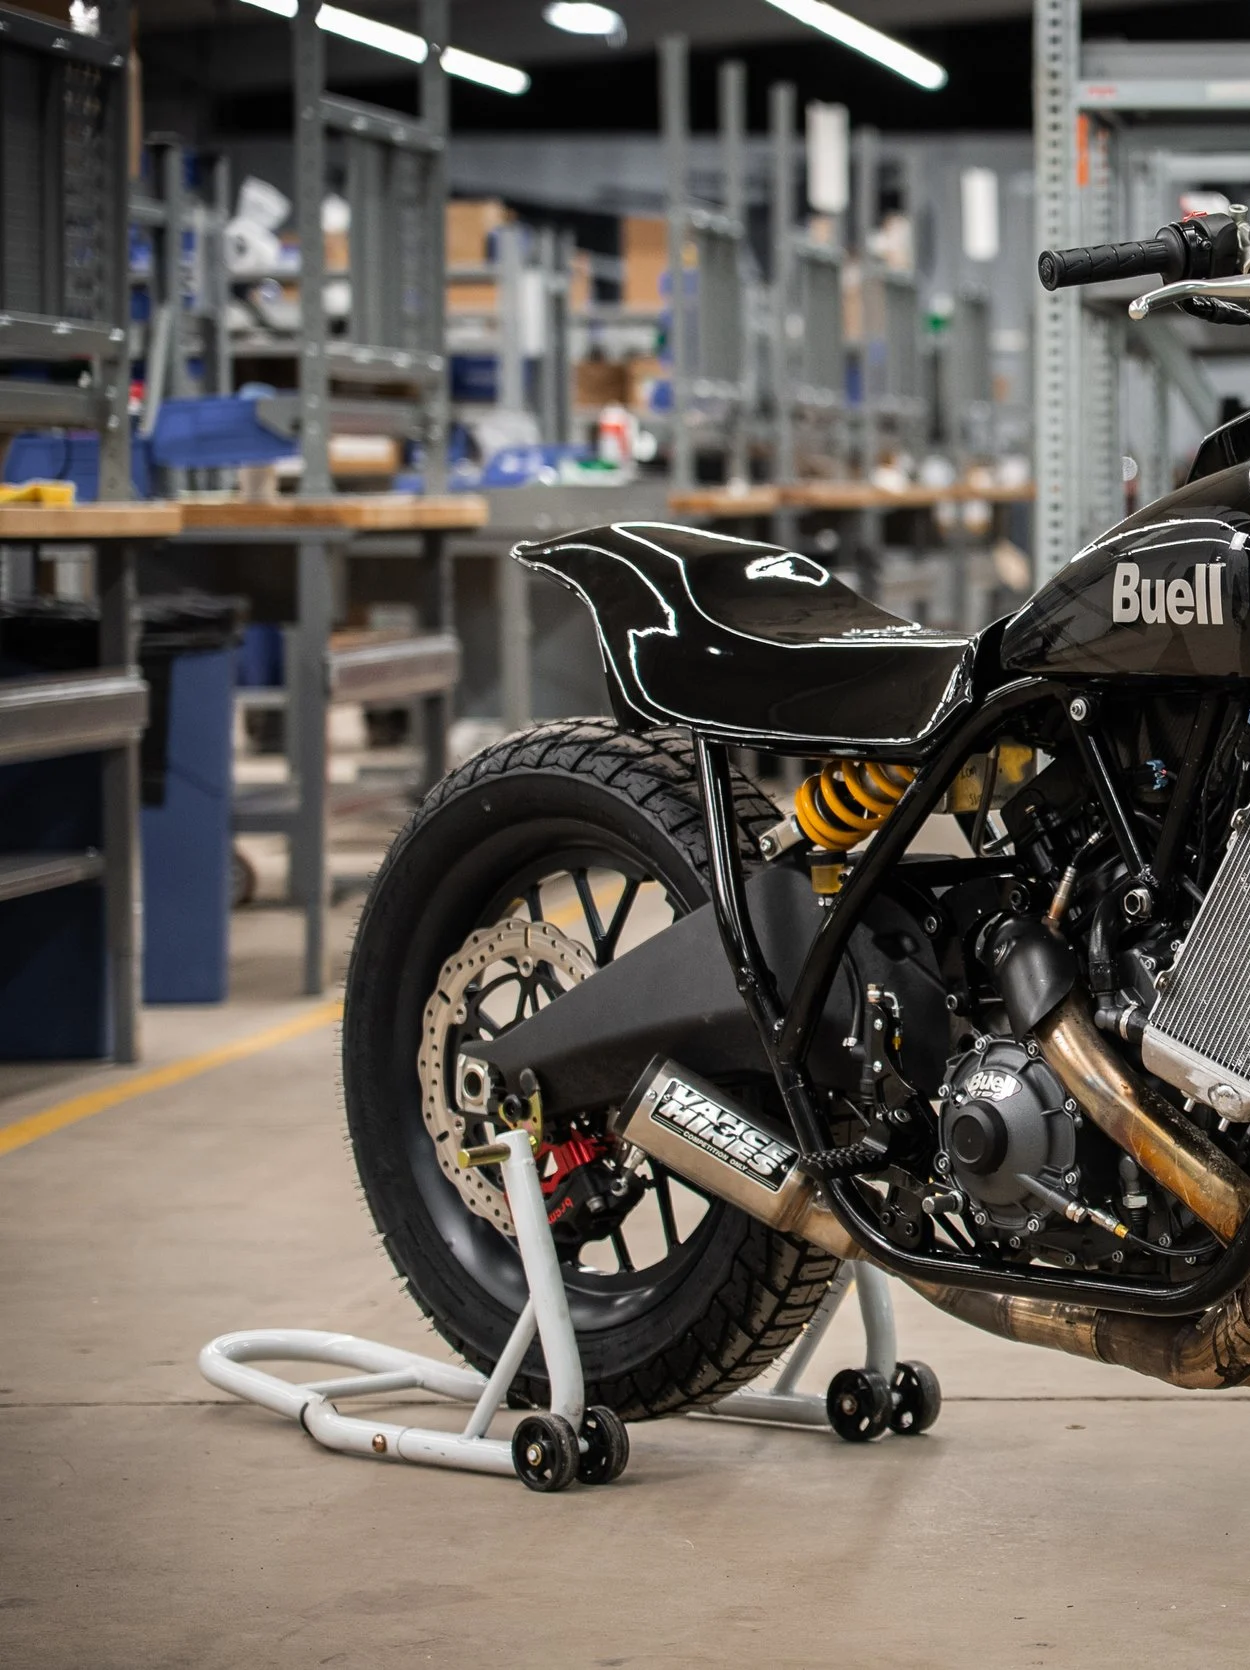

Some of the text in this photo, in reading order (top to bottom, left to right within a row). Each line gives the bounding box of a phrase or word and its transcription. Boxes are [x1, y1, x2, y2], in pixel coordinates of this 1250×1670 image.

[1112, 562, 1224, 626] Buell
[967, 1071, 1017, 1098] Buell
[657, 1099, 783, 1177] HINES
[670, 1084, 795, 1164] VANCE
[682, 1130, 730, 1162] COMPETITION
[729, 1158, 748, 1172] ONLY
[548, 1197, 574, 1226] brem
